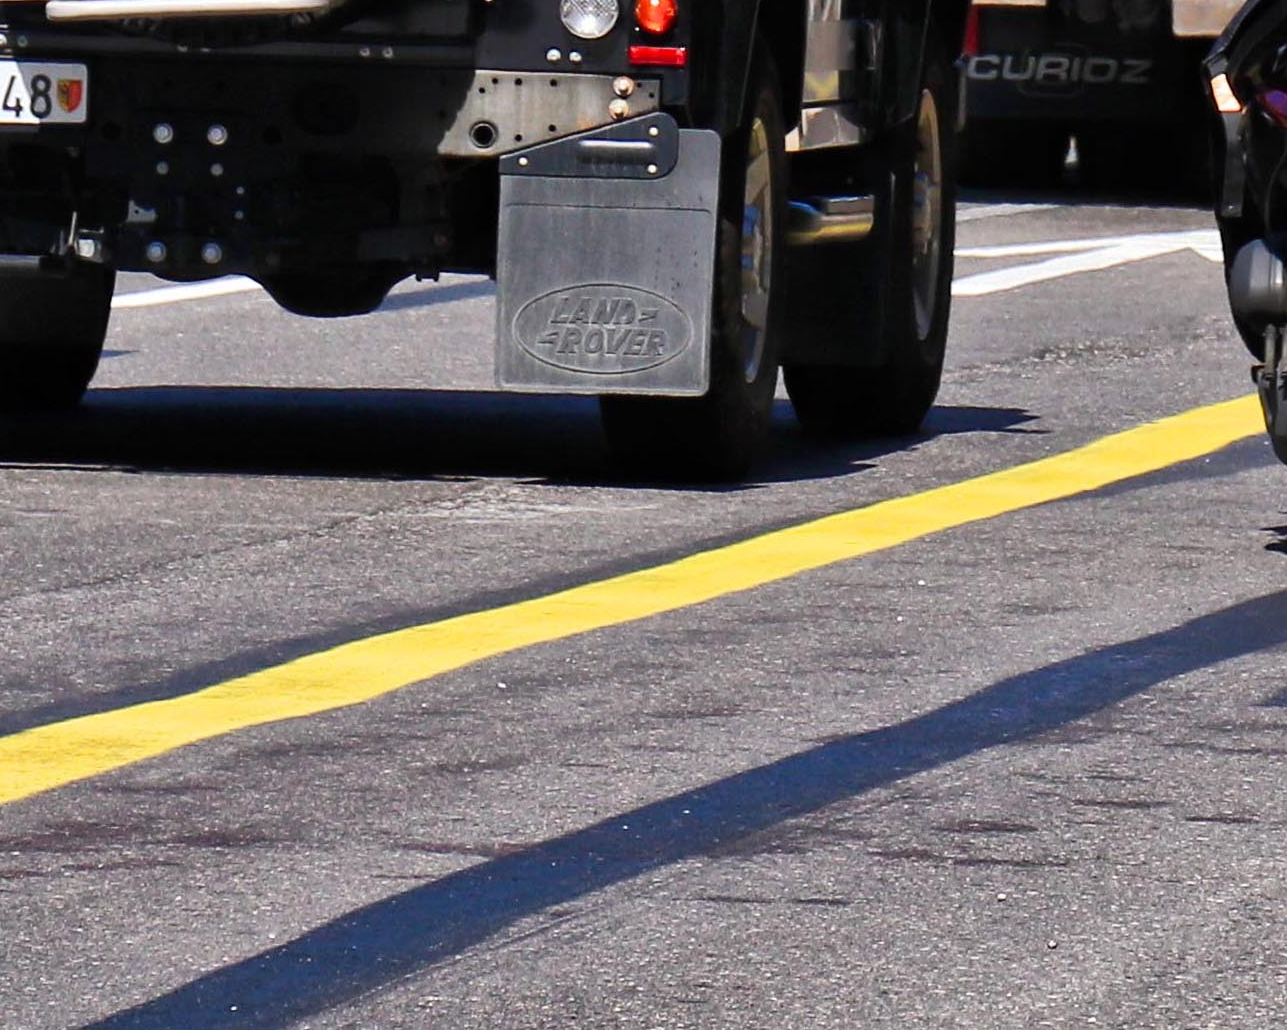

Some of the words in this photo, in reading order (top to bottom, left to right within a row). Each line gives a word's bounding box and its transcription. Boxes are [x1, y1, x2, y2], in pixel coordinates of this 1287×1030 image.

[966, 53, 1155, 84] CURIOZ
[549, 296, 637, 325] LAND
[556, 326, 668, 357] ROVER
